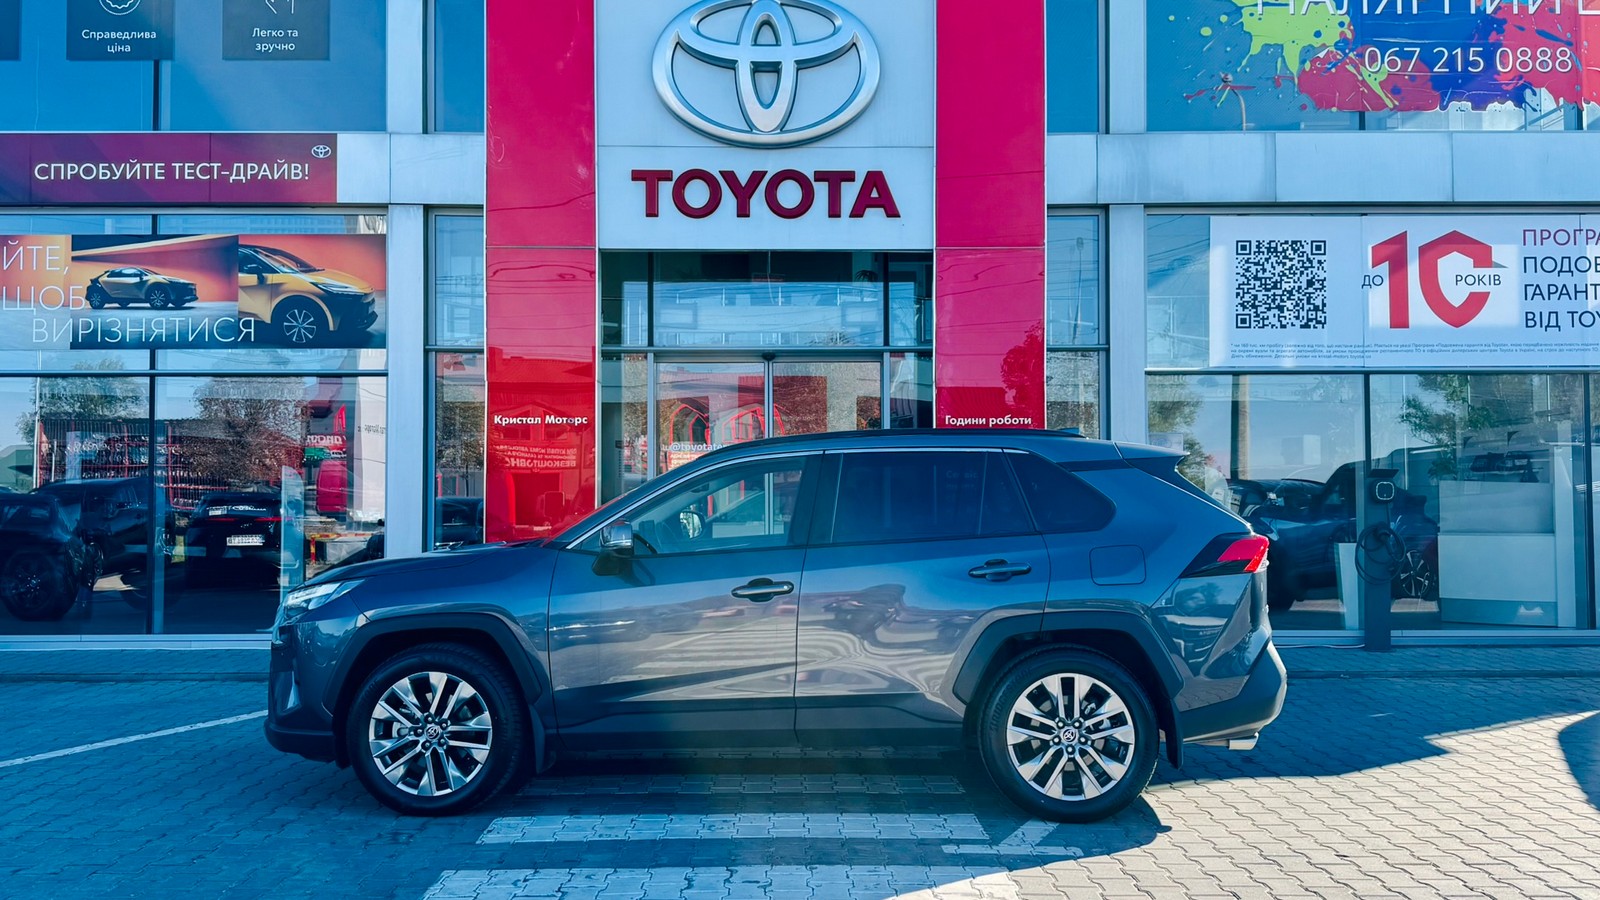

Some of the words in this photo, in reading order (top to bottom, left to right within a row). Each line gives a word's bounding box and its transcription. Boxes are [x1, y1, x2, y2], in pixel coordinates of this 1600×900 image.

[81, 29, 157, 41] Справедлива
[252, 28, 285, 39] Легко
[286, 29, 299, 38] та
[107, 43, 131, 54] ціна
[255, 43, 296, 52] зручно
[1364, 47, 1420, 73] 067
[1433, 47, 1484, 73] 215
[1495, 47, 1573, 73] 0888
[34, 159, 165, 181] СПРОБУЙТЕ
[171, 159, 310, 184] ТЕСТ-ДРАЙВ!
[631, 168, 901, 219] TOYOTA
[3, 240, 69, 276] ЙТЕ,
[1361, 275, 1384, 289] ДО
[1455, 274, 1501, 286] РОКІВ
[2, 285, 86, 316] ЩОБ
[32, 317, 256, 343] ВИРІЗНЯТИСЯ
[1525, 311, 1561, 332] ВІД
[494, 415, 542, 427] Кристал
[545, 415, 588, 427] Моторс
[945, 415, 986, 426] Години
[990, 414, 1032, 428] роботи
